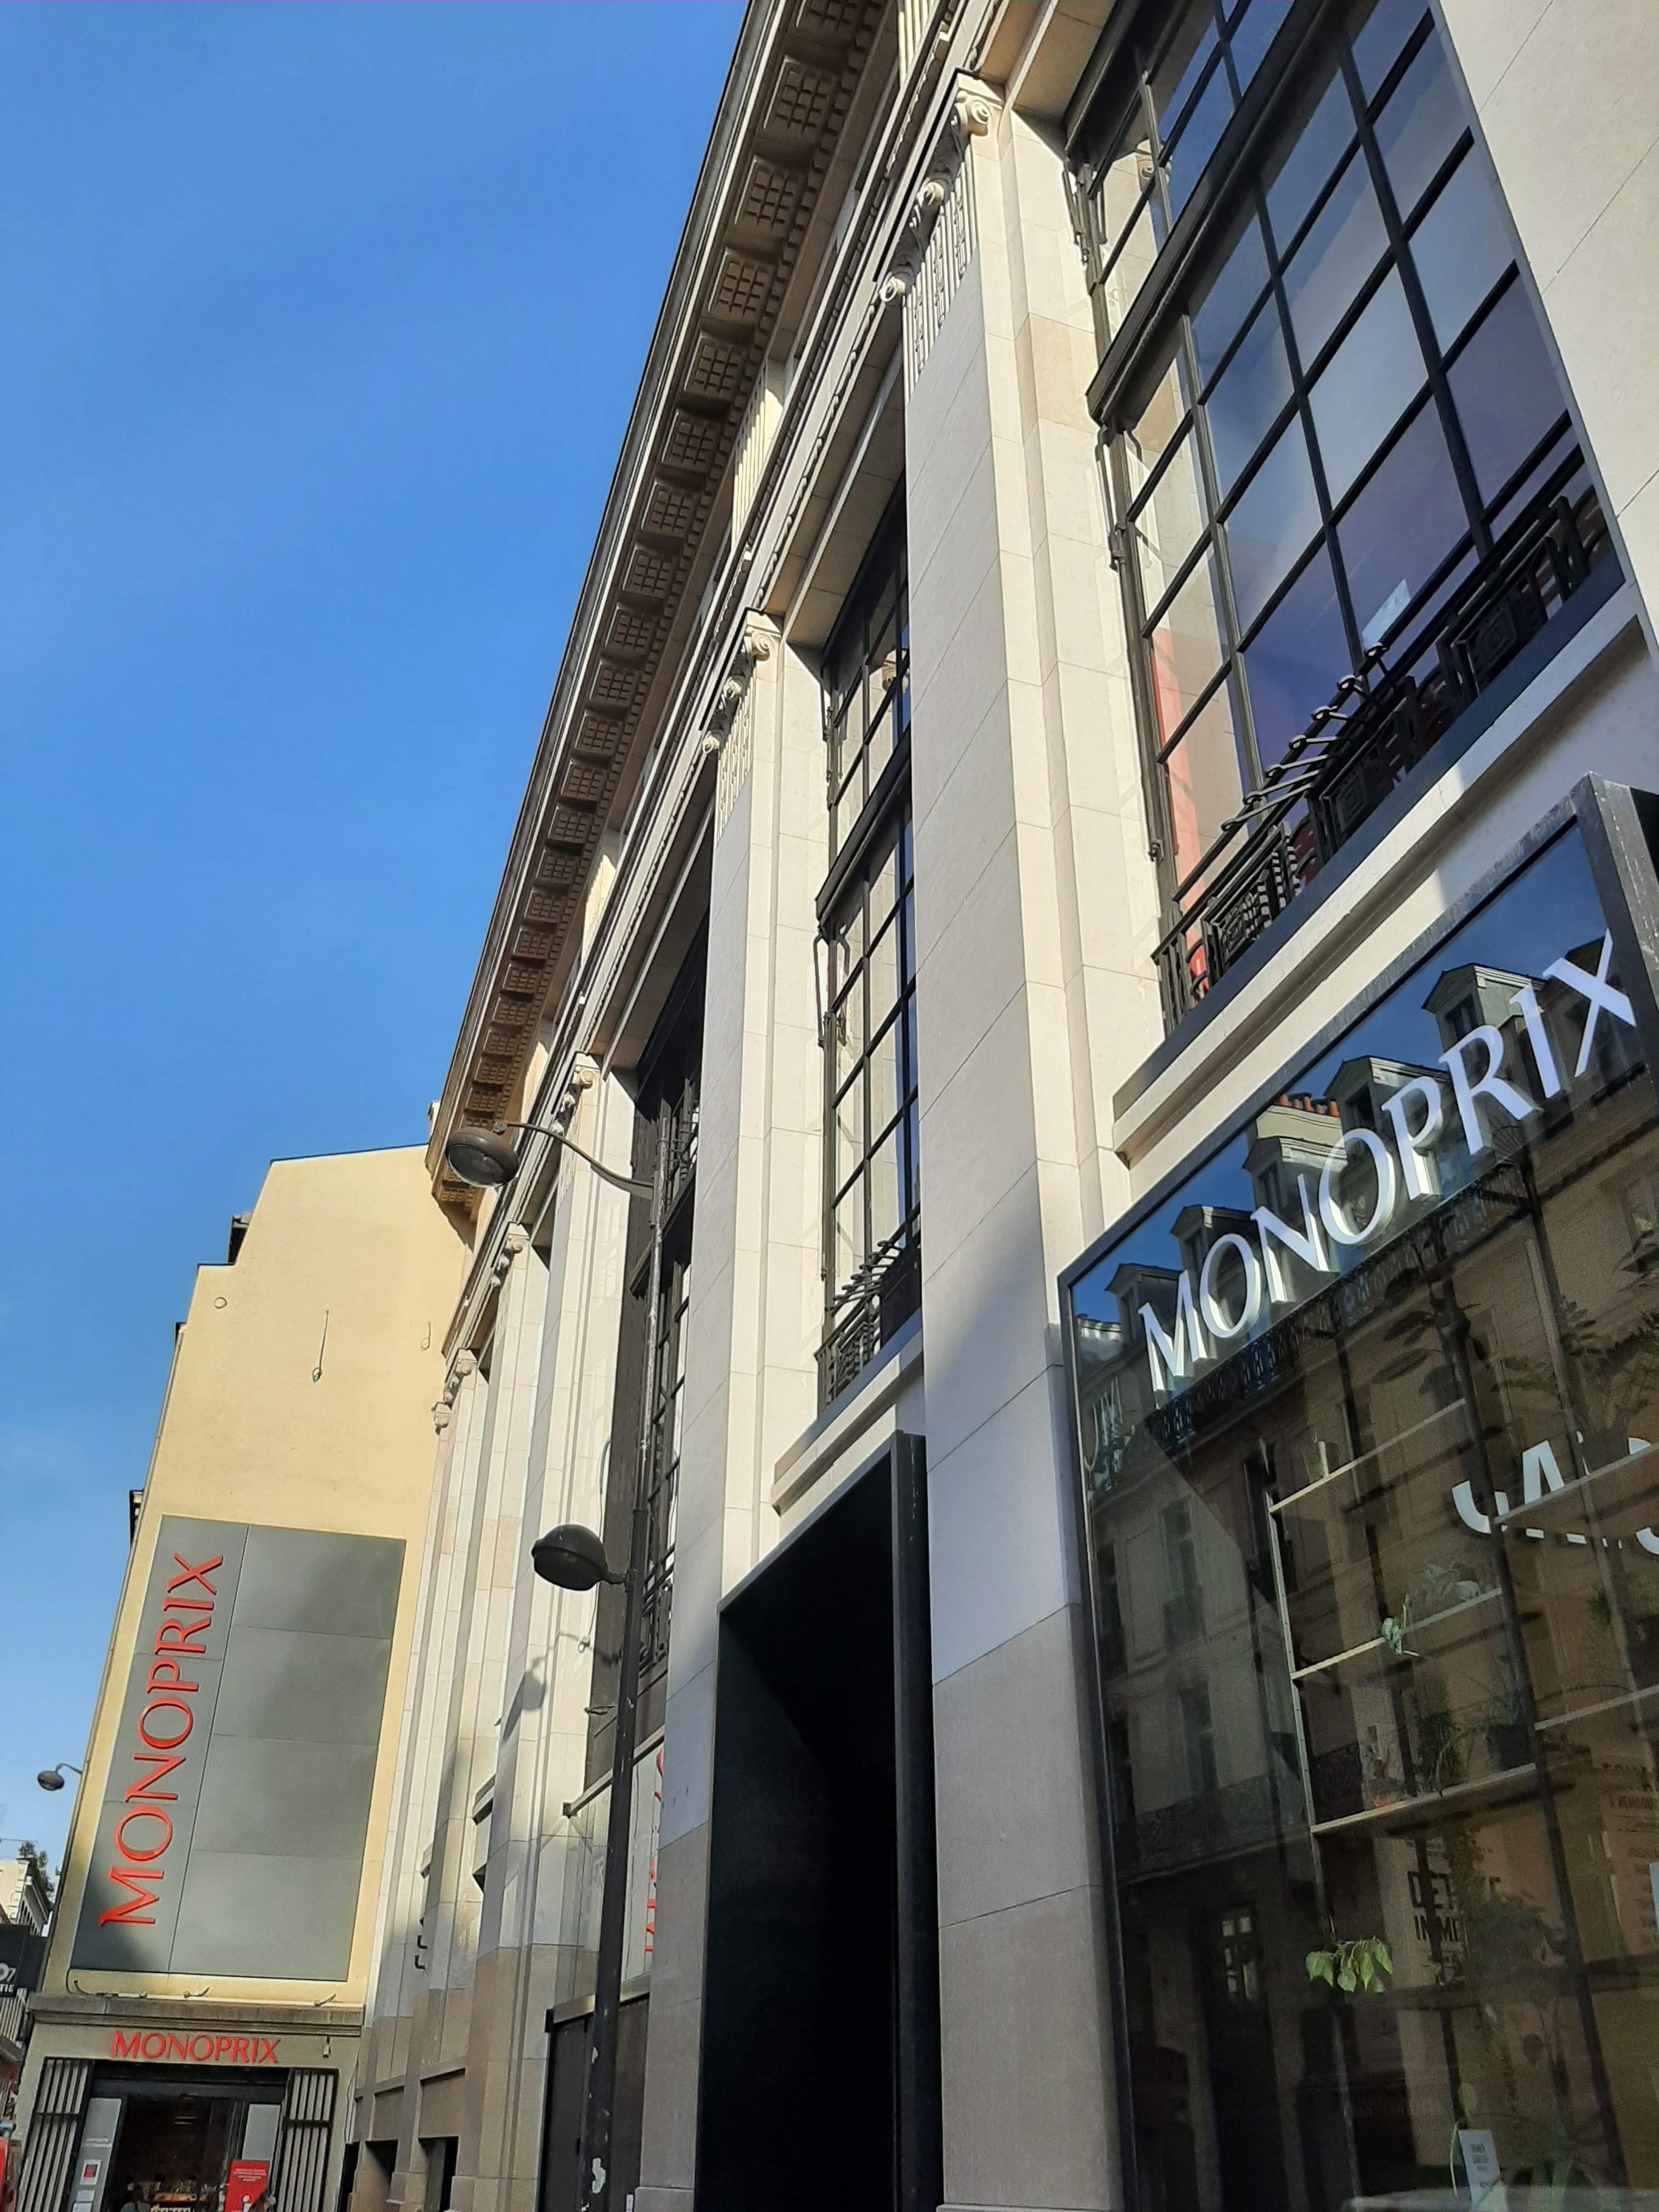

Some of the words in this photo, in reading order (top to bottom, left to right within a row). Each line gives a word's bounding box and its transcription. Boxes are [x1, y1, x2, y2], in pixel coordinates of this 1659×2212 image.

[1137, 927, 1637, 1394] MONOPRIX
[97, 1551, 223, 1928] MONOPRIX
[110, 2031, 281, 2063] MONOPRIX
